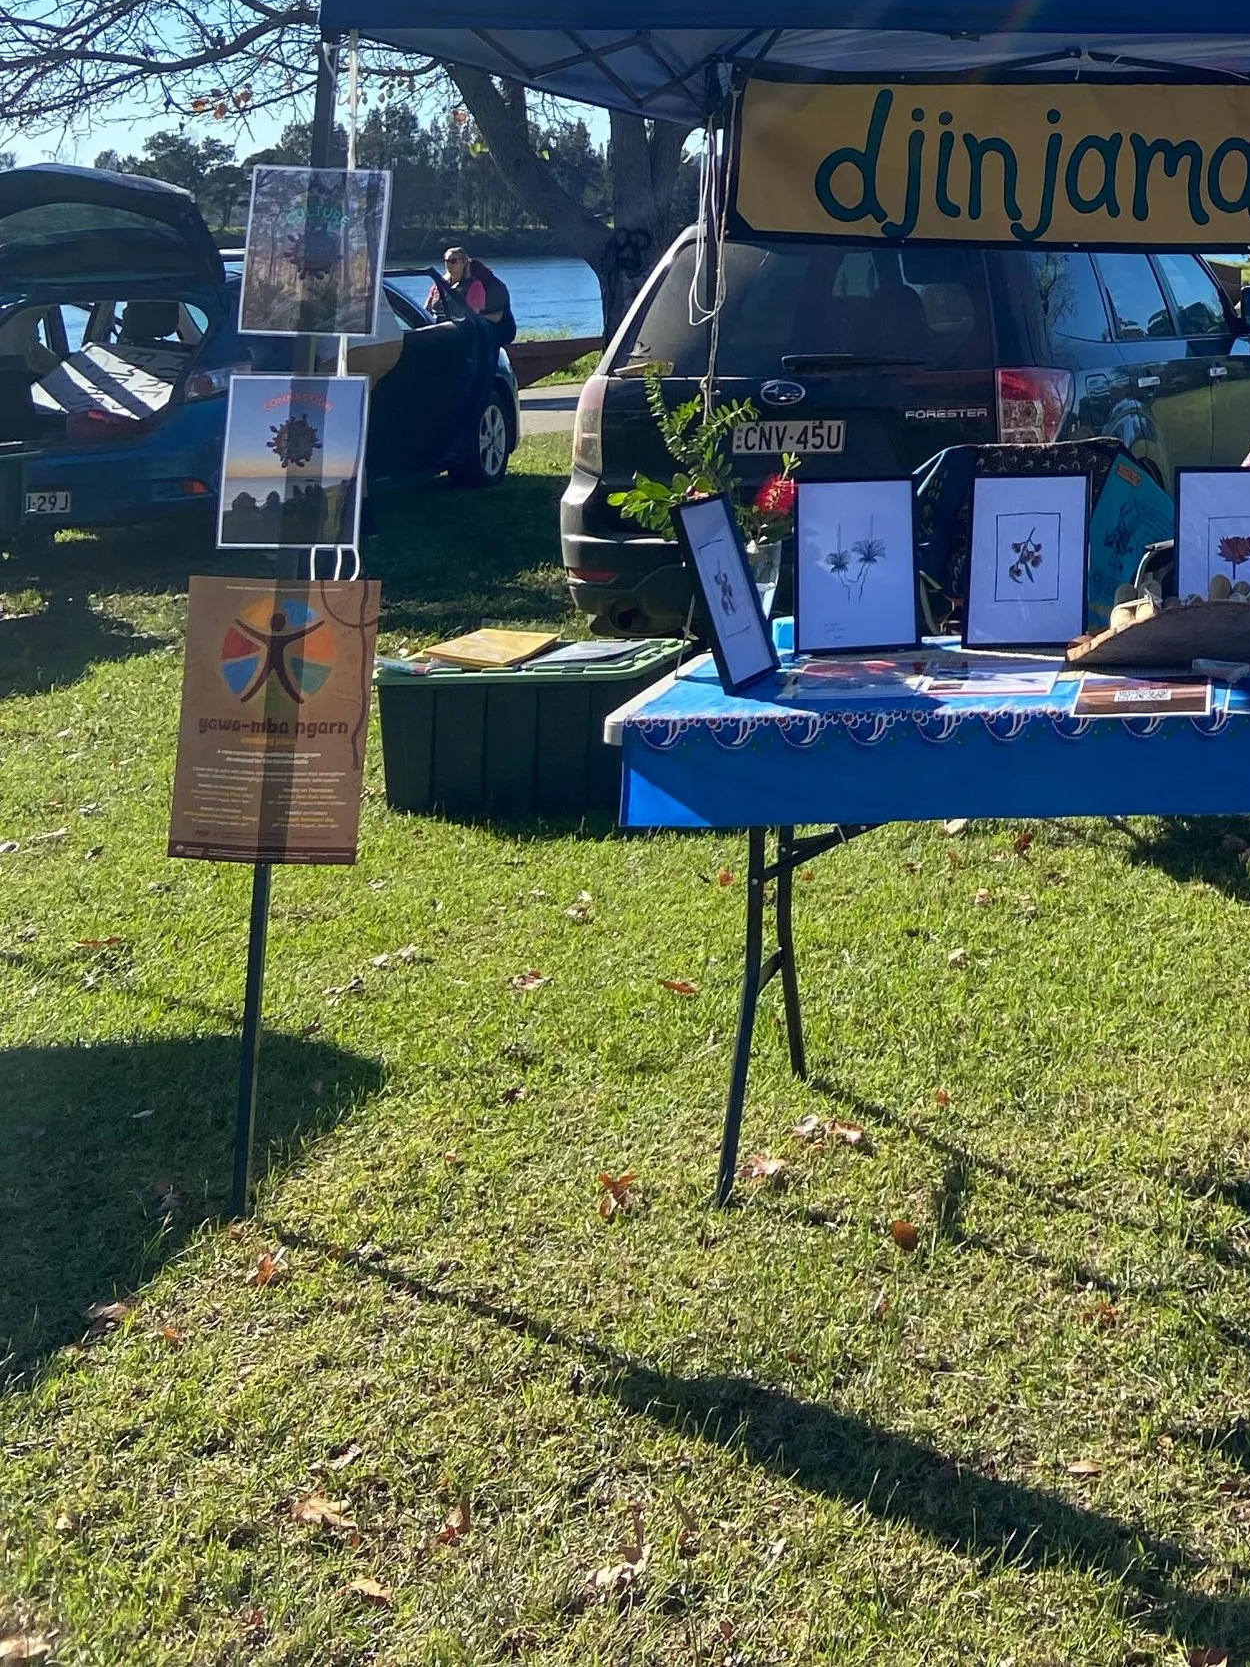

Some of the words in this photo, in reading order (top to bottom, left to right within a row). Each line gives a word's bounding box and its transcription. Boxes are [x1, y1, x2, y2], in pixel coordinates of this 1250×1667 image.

[905, 407, 988, 419] FORESTER
[198, 717, 289, 735] yawa-mba
[296, 719, 349, 739] ngarn
